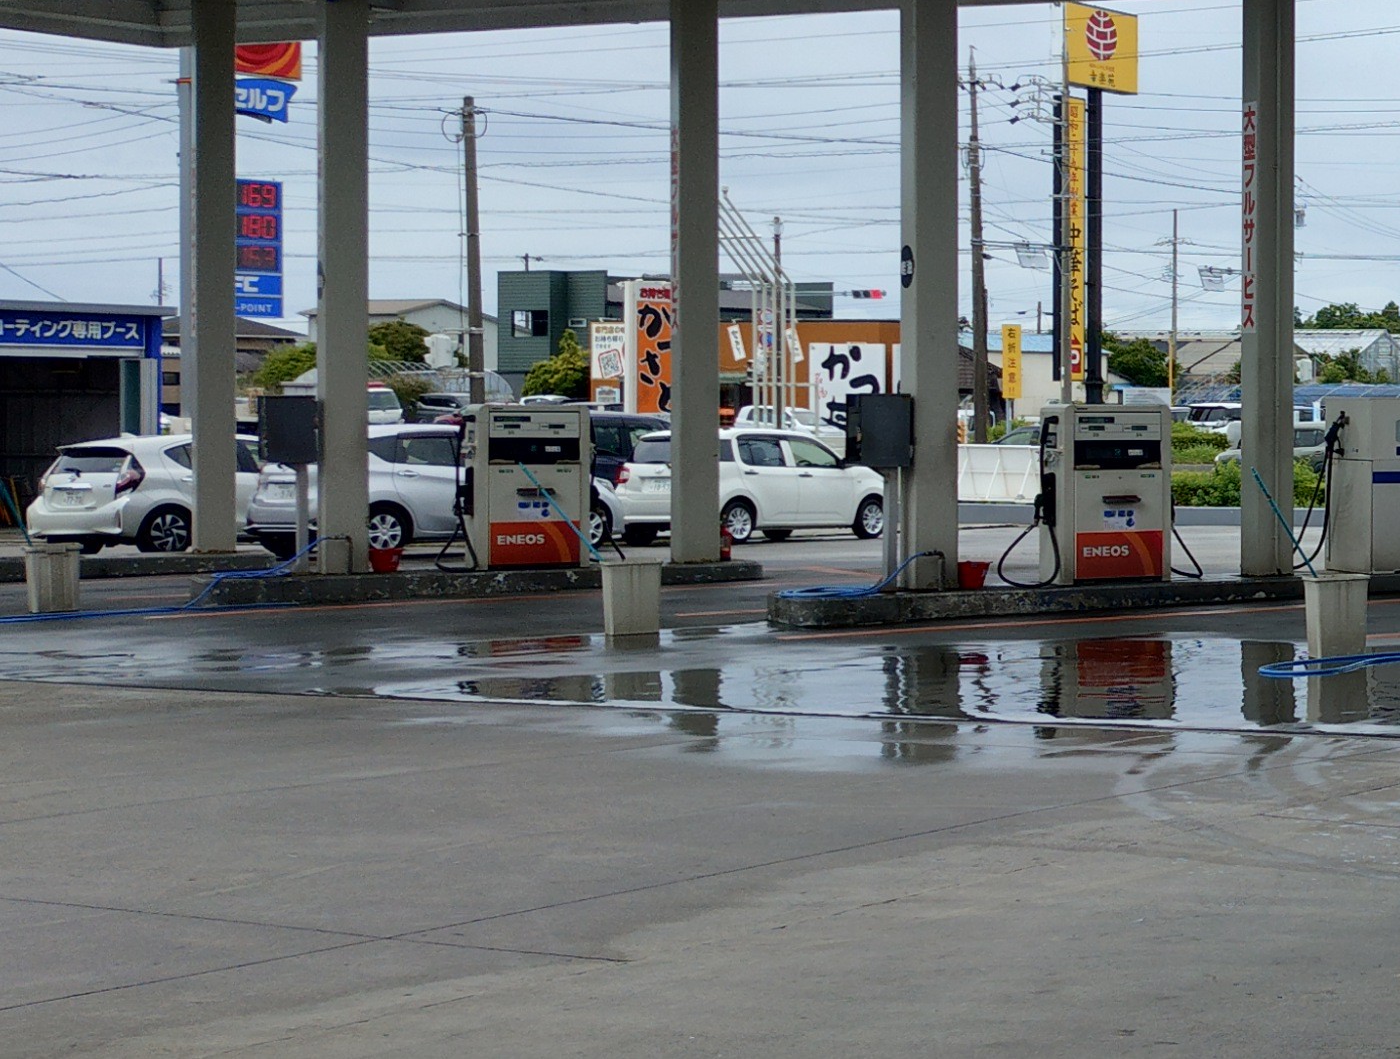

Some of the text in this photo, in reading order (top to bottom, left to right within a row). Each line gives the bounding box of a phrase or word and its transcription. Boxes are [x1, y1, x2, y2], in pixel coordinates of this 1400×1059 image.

[242, 183, 276, 207] 169
[242, 214, 276, 239] 180
[1242, 105, 1256, 329] 大型フルサービス
[0, 319, 139, 340] ーティング専用ブース
[496, 534, 546, 546] ENEOS
[1082, 545, 1131, 558] ENEOS
